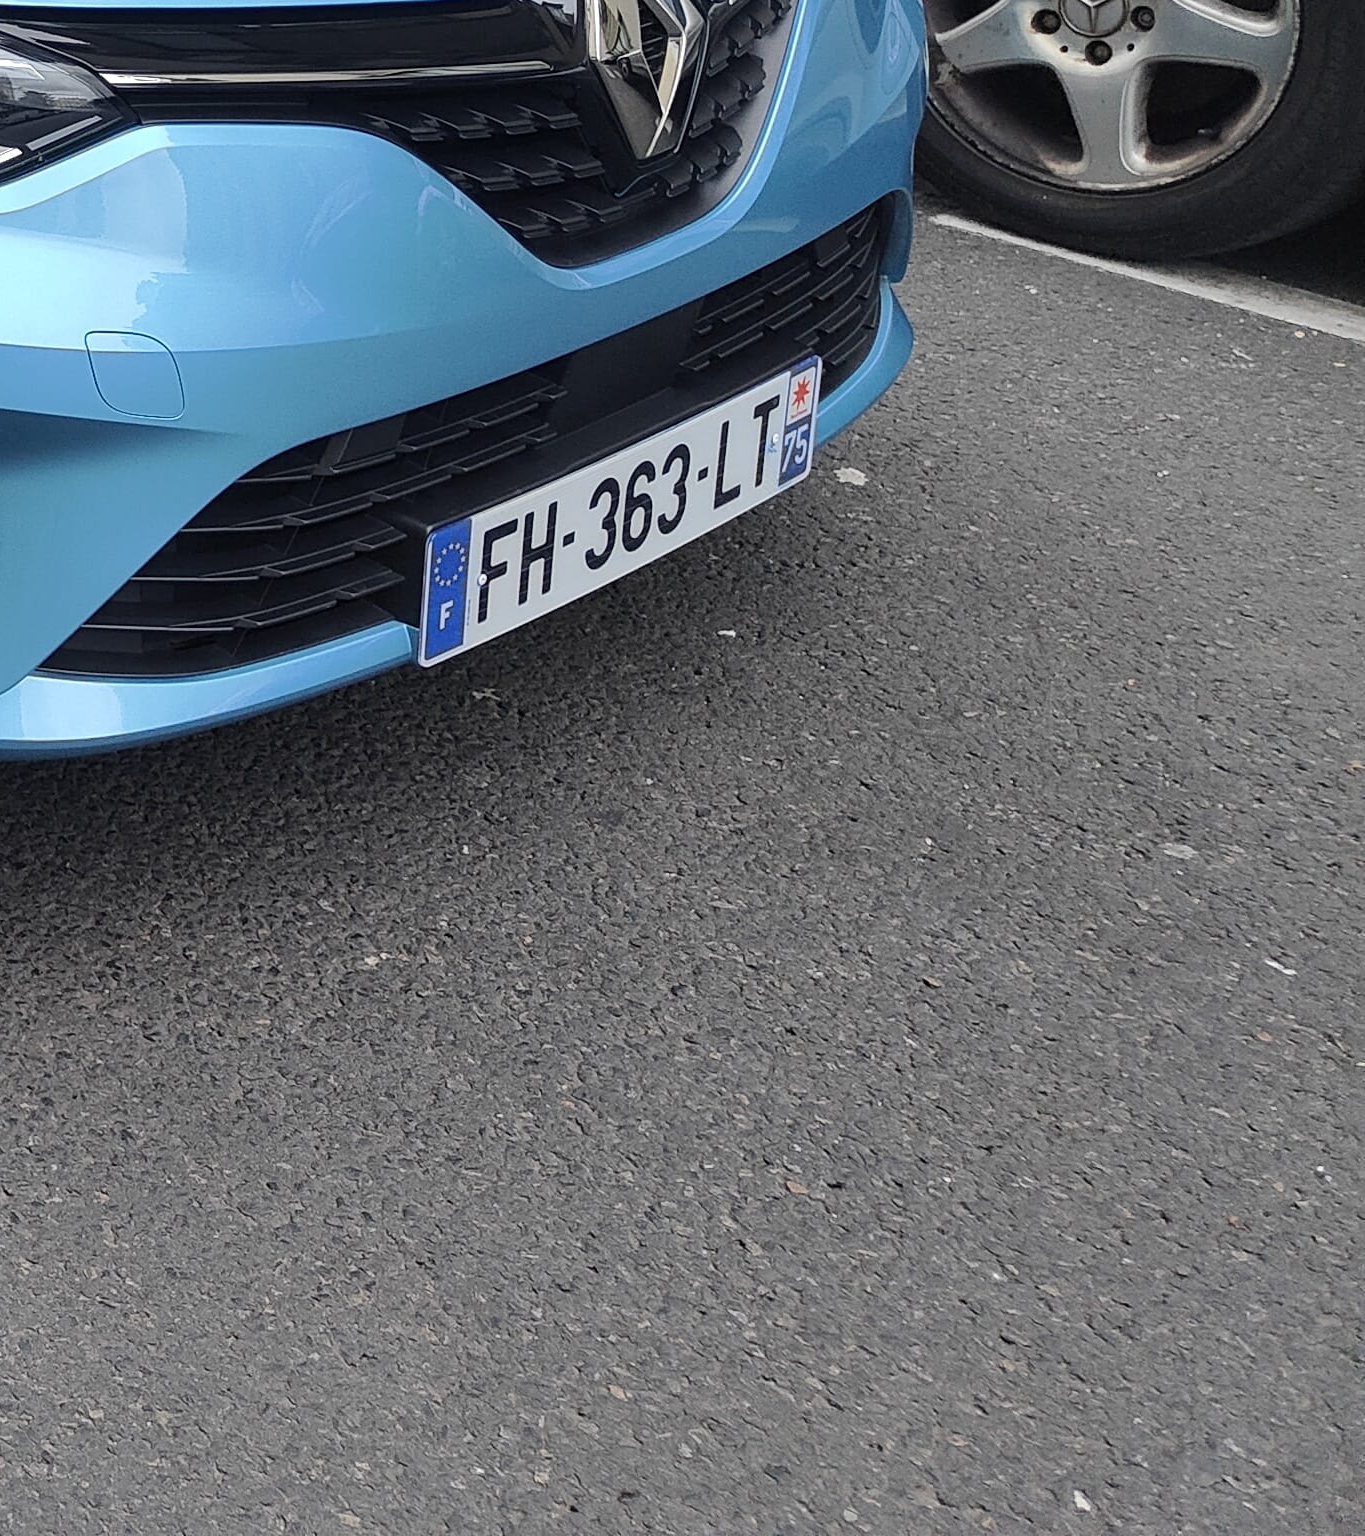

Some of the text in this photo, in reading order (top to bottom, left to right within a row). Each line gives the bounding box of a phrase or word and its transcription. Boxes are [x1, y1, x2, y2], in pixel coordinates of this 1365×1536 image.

[781, 423, 809, 473] 75
[477, 394, 782, 624] FH-363-LT
[438, 600, 454, 631] F
